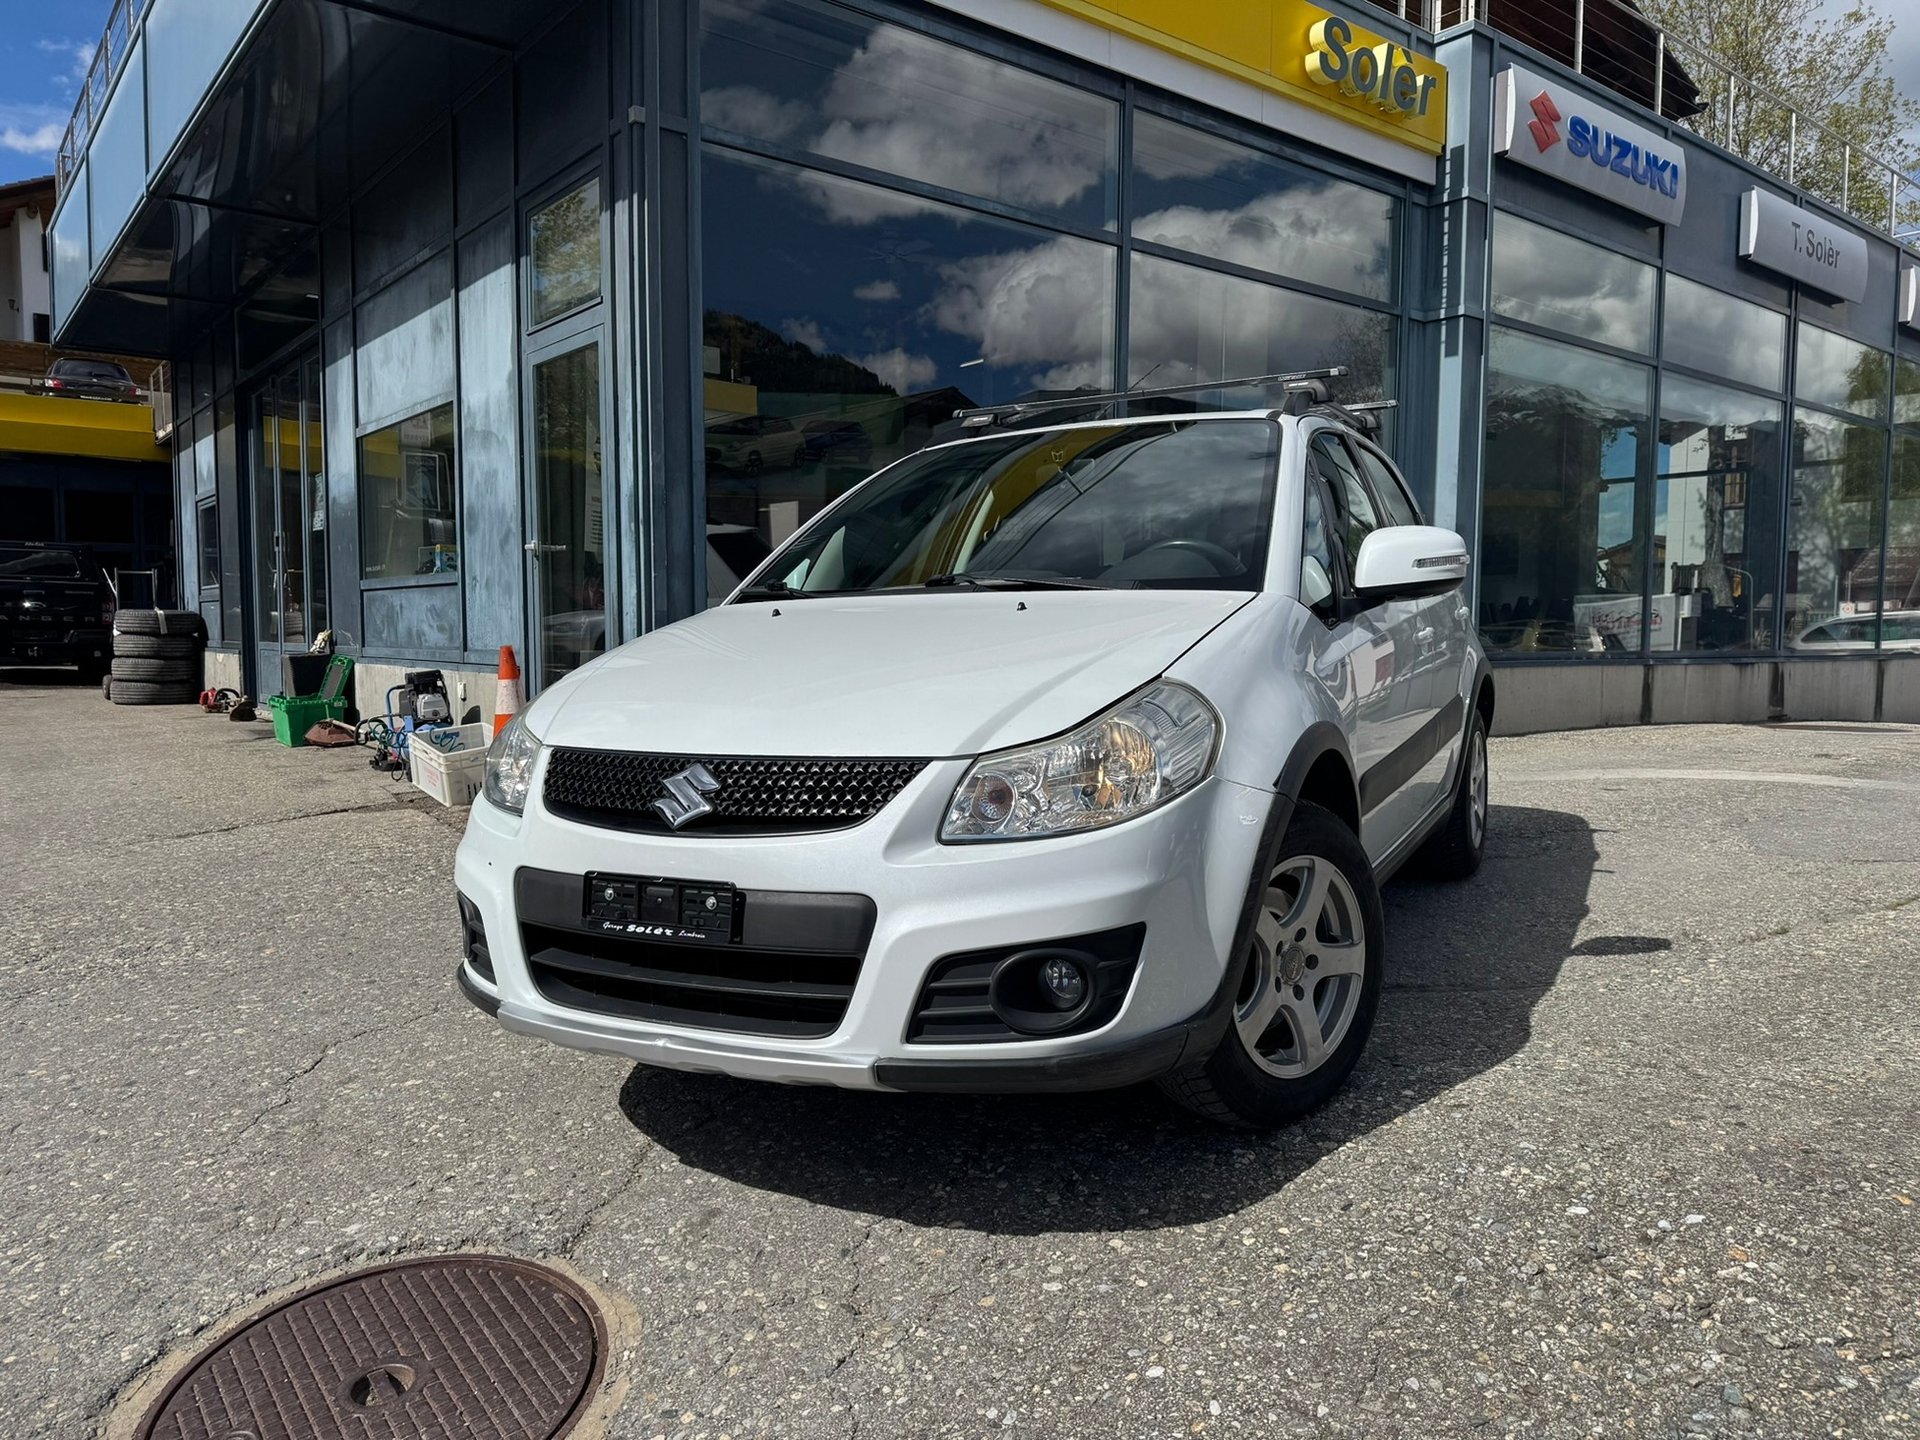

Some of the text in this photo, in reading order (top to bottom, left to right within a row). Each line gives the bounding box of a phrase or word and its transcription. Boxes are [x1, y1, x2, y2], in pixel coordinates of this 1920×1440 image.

[1306, 16, 1437, 117] Solèr
[1567, 115, 1678, 199] SUZUKI
[1792, 221, 1840, 268] T. Solèr
